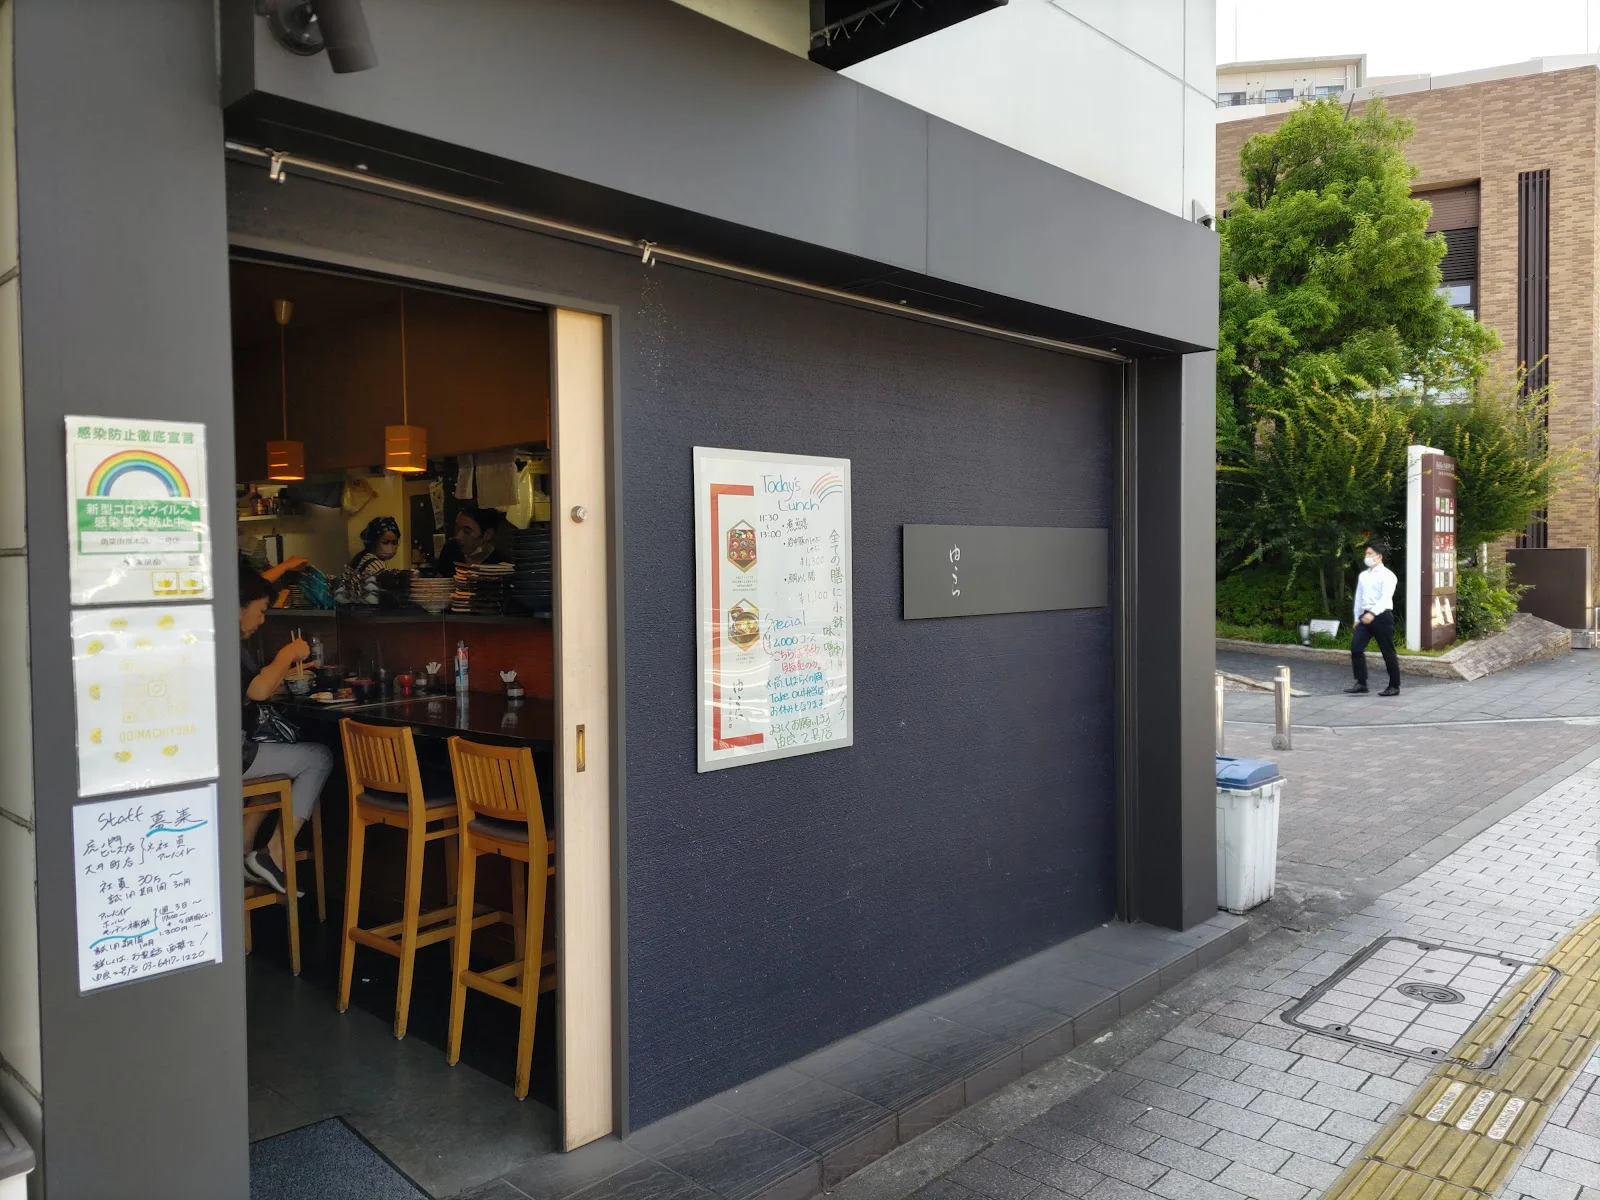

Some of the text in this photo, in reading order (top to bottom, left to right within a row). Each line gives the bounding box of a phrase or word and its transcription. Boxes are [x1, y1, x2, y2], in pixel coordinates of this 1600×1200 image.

[77, 426, 195, 445] 感染防止徹底宣言
[760, 474, 801, 501] Today's
[86, 503, 192, 516] 新型コロナウイルス
[778, 498, 820, 512] Lunch
[94, 516, 186, 529] 感染拡大防止中
[759, 513, 779, 522] 11:30
[760, 530, 782, 539] 13:00
[764, 610, 806, 632] Special
[769, 691, 790, 703] Take
